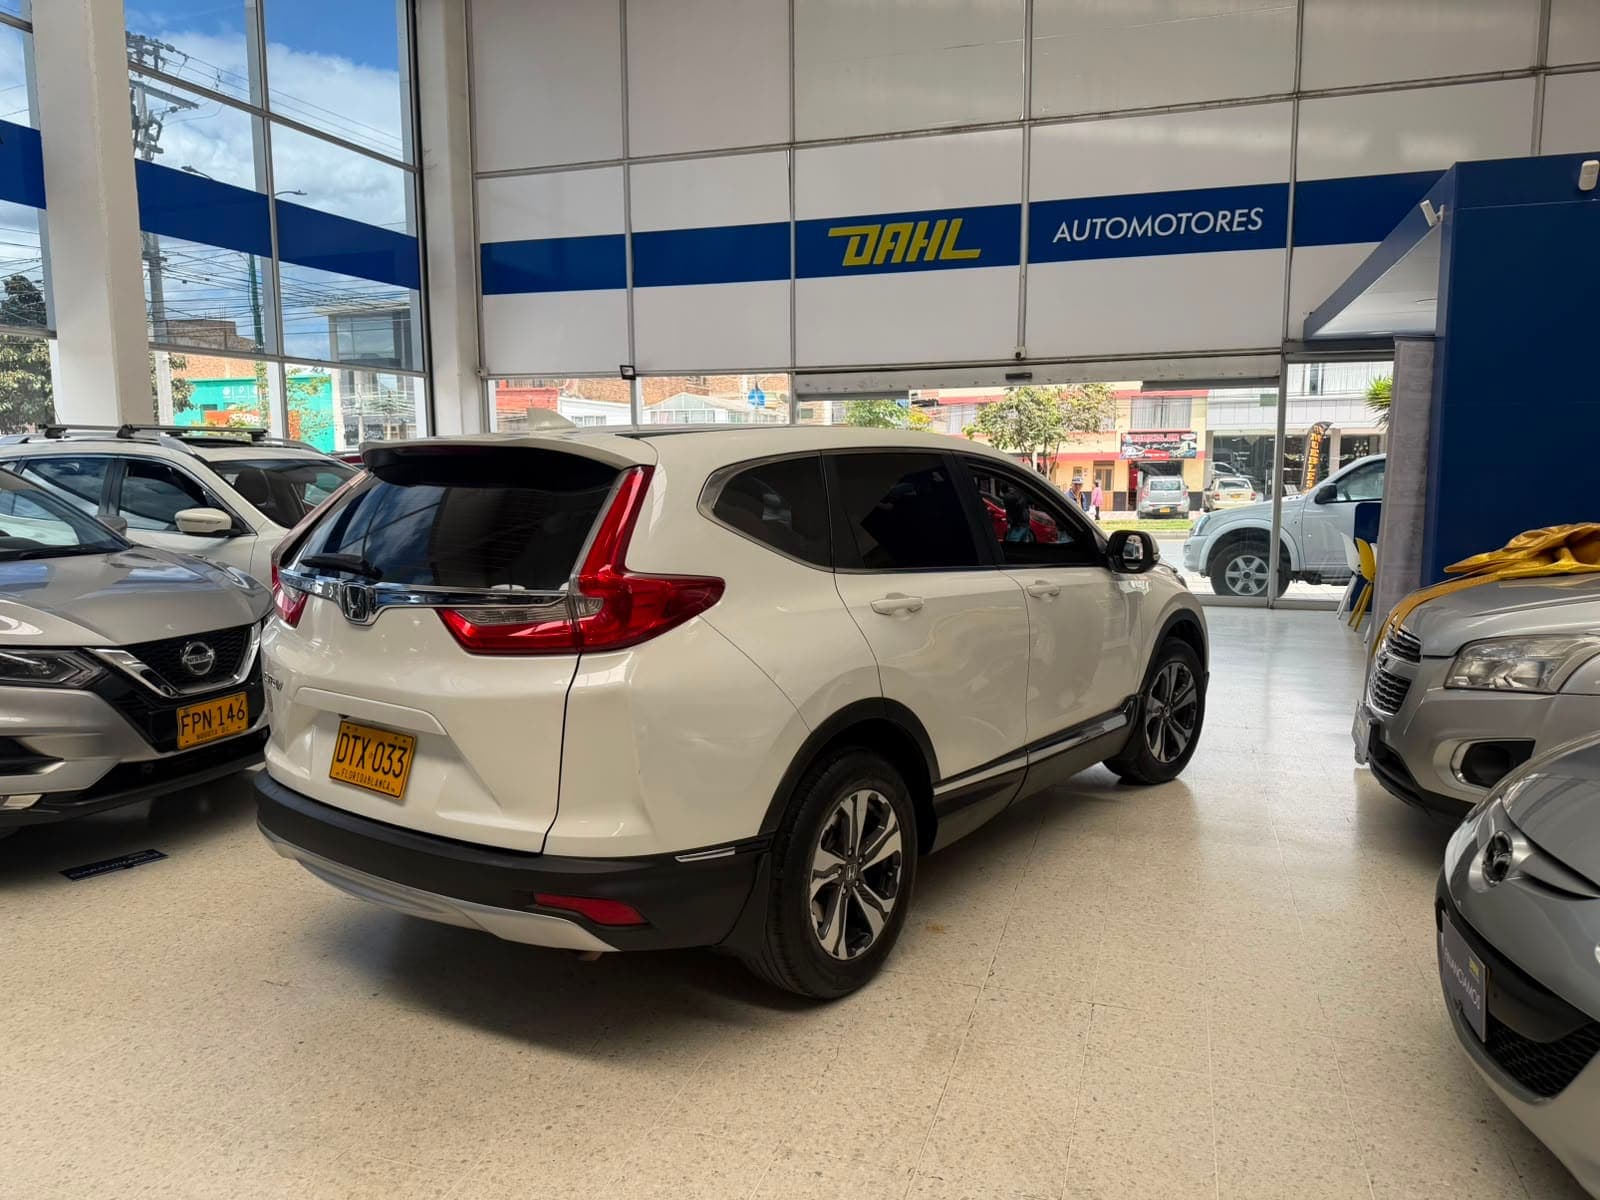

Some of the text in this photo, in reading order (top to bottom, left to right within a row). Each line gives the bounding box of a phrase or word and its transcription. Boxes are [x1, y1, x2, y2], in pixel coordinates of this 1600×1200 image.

[828, 207, 1264, 266] DAHL AUTOMOTORES
[181, 700, 246, 736] FPN 146
[336, 732, 408, 778] DTX 033
[341, 767, 391, 790] FLORIDABLANCA
